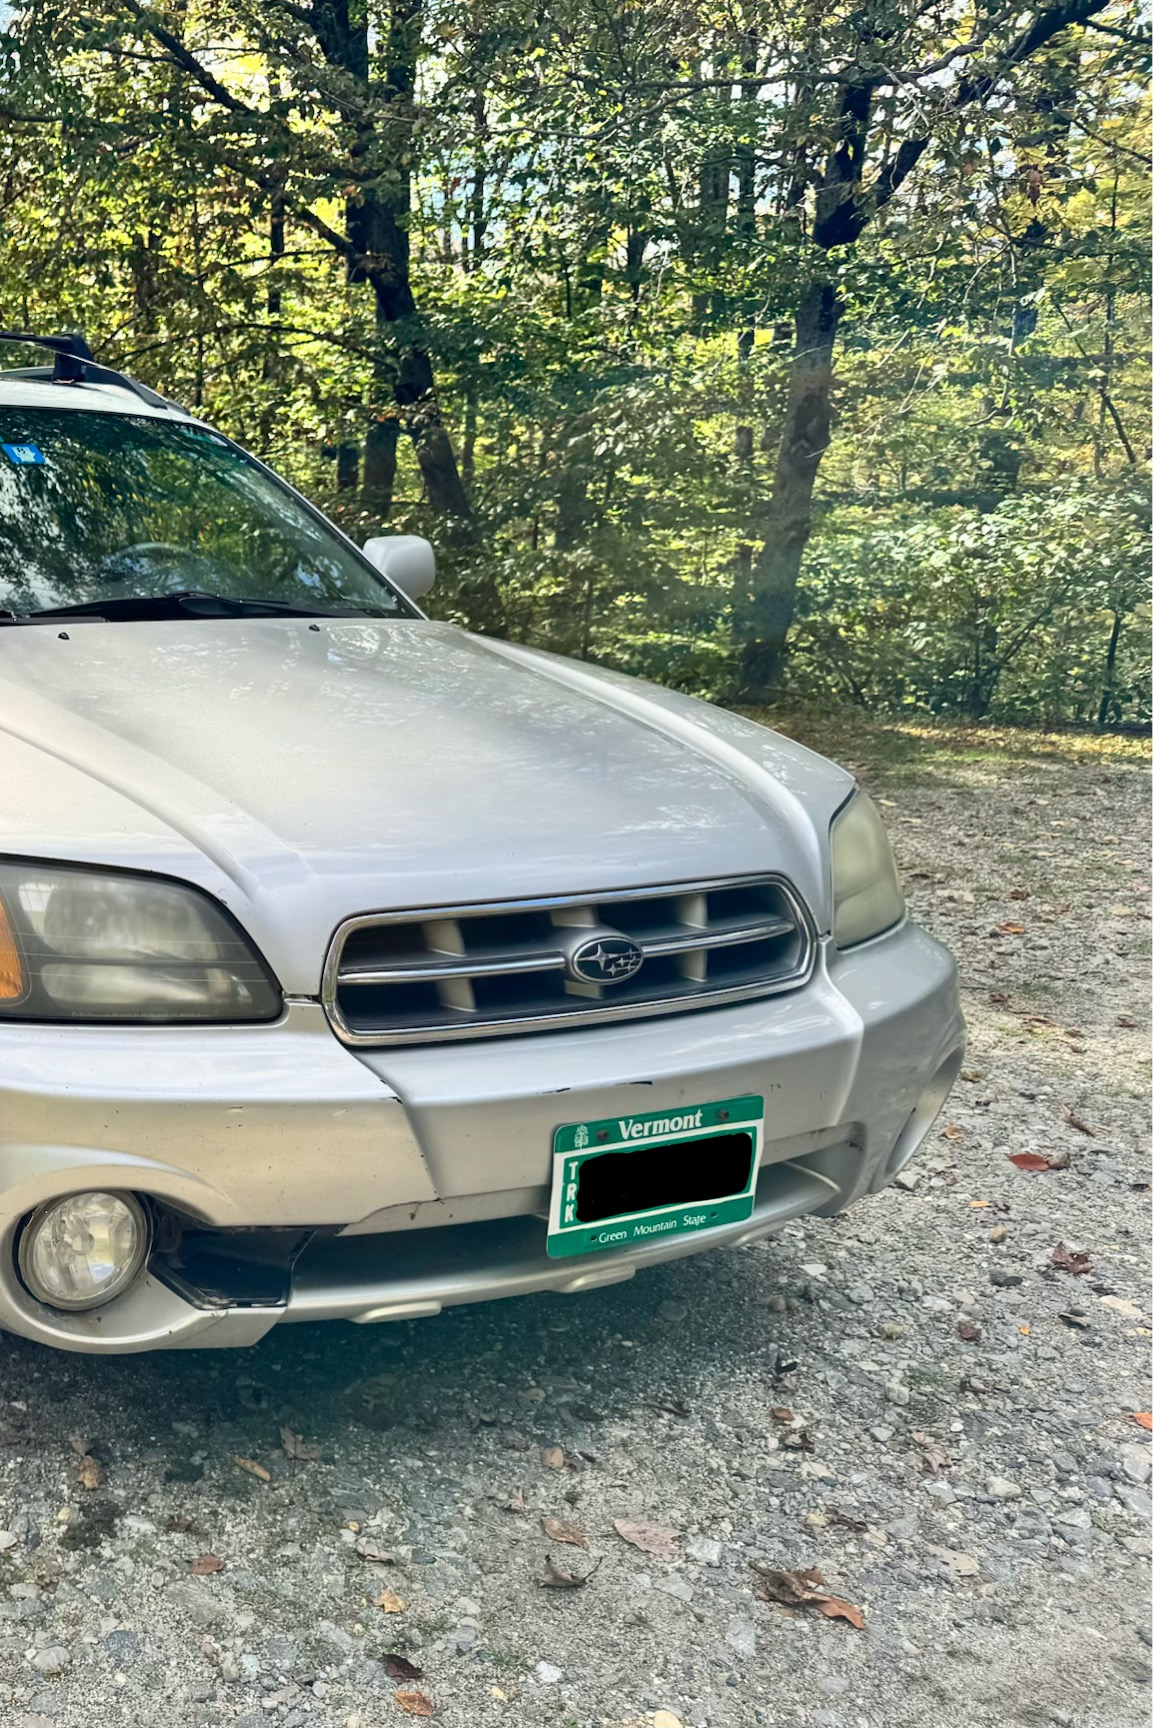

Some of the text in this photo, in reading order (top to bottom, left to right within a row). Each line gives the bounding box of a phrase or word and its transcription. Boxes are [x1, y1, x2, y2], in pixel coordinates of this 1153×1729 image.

[618, 1109, 703, 1140] Vermont
[564, 1161, 579, 1222] TRK
[598, 1214, 706, 1243] Green Mountain State
